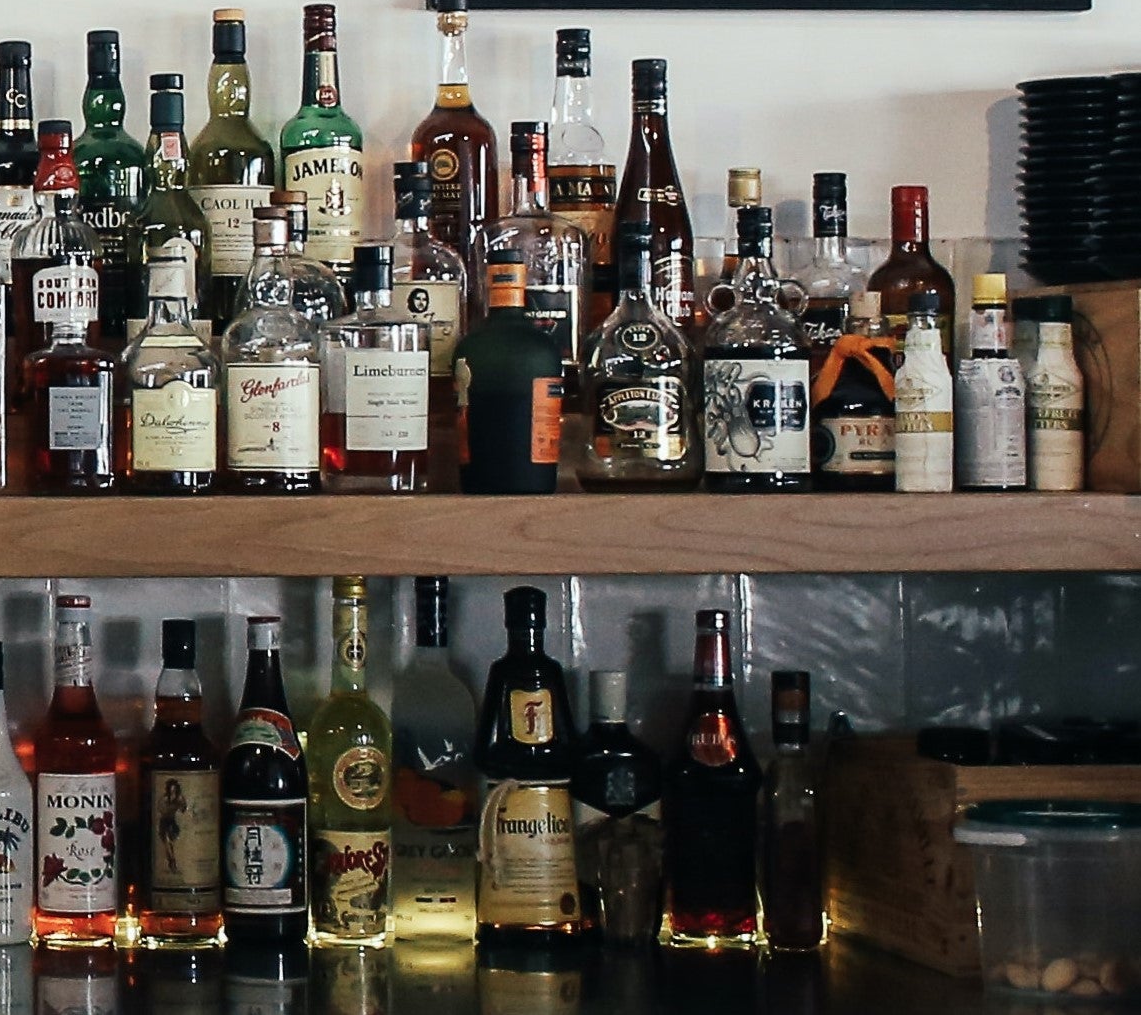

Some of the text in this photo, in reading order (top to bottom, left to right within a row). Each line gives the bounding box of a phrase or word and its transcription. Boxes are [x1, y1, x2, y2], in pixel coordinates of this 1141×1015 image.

[292, 157, 362, 182] JAMEON
[200, 197, 242, 212] CAOL
[225, 218, 245, 230] 12
[271, 421, 281, 434] 8
[46, 793, 113, 809] MONIN
[65, 845, 96, 861] Rose
